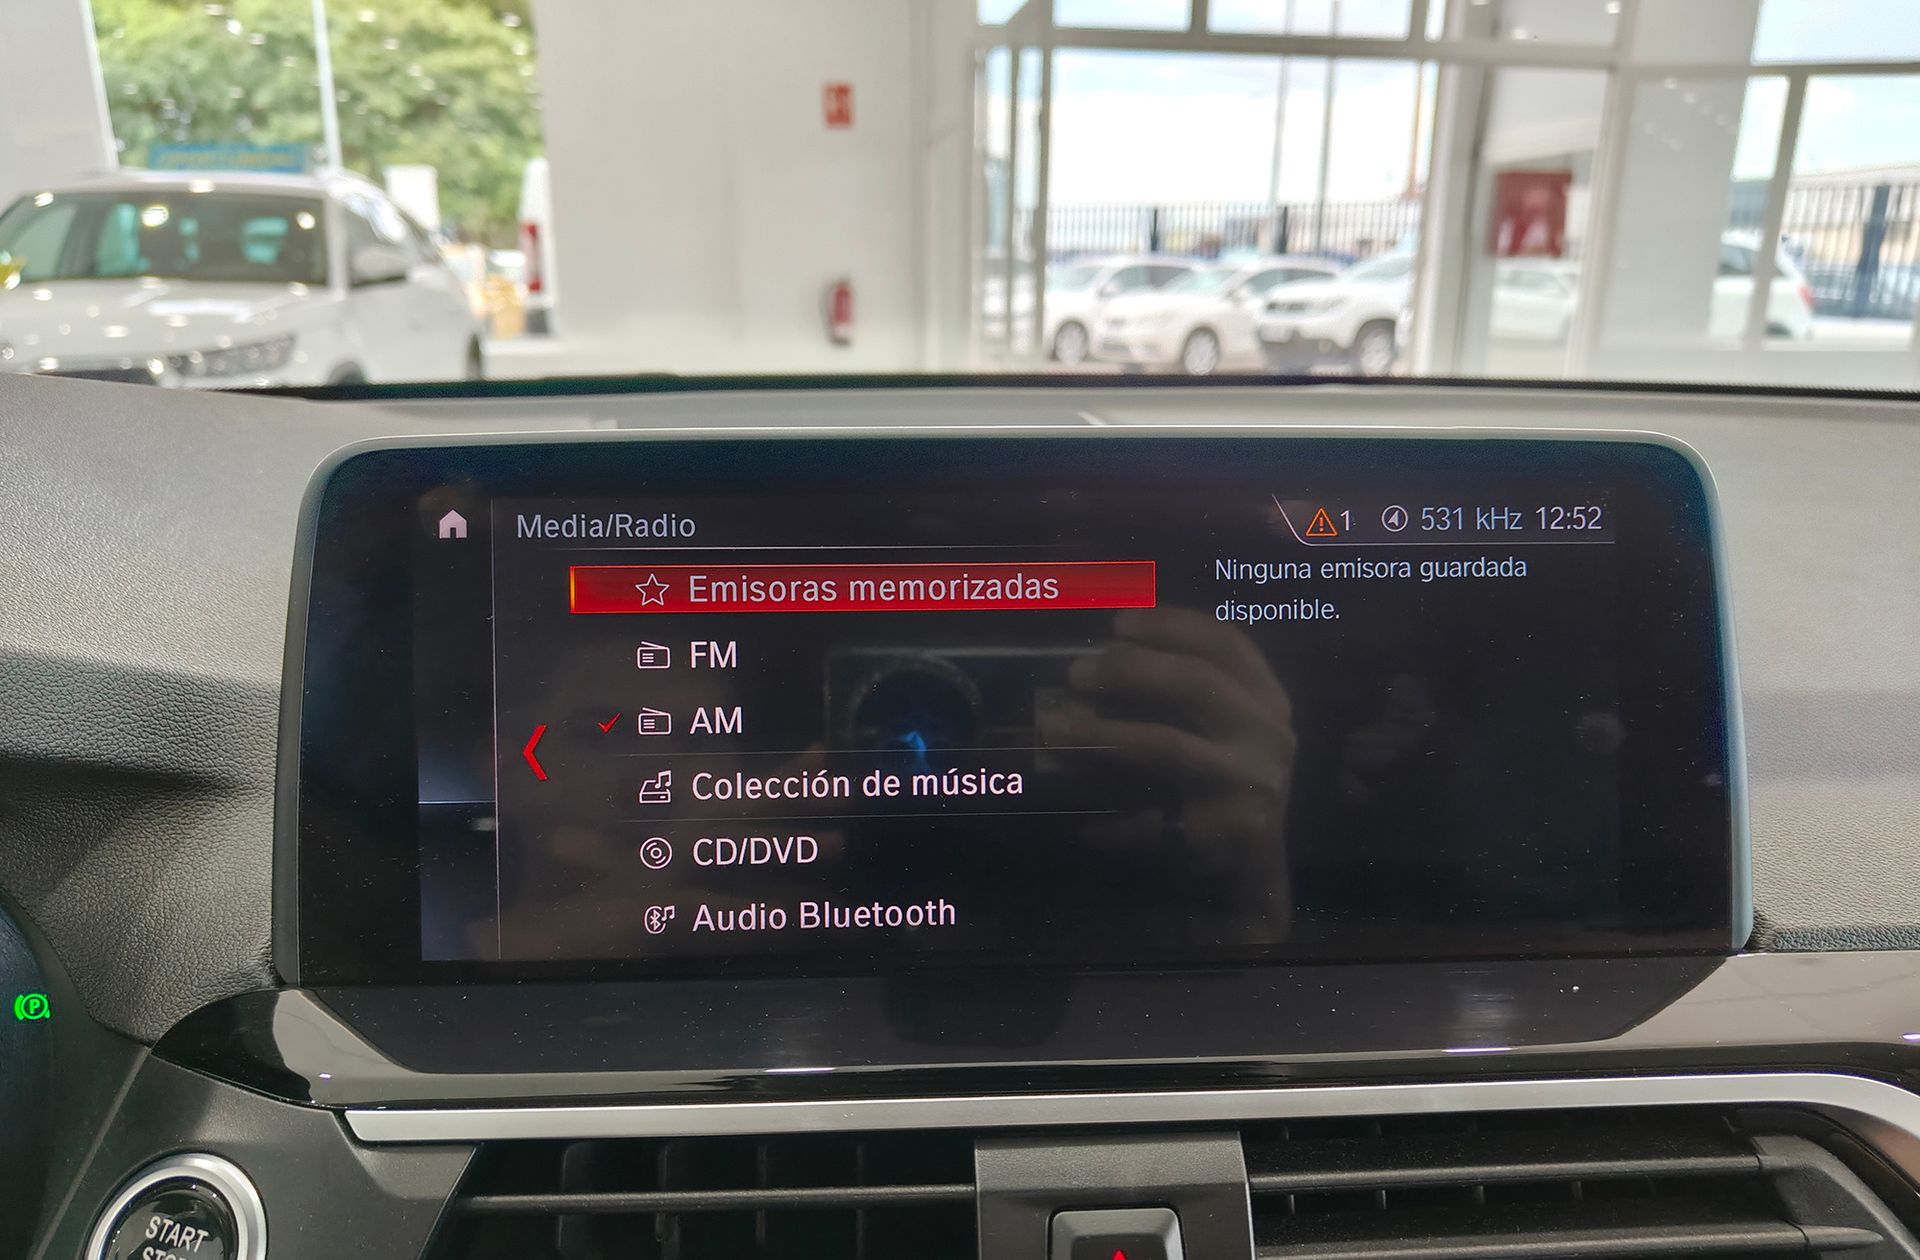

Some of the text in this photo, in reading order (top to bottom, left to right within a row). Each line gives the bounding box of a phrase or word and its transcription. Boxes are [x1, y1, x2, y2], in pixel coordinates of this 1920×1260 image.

[516, 512, 696, 540] Media/Radio
[1339, 510, 1353, 531] 1
[1420, 506, 1523, 531] 531 kHz
[1535, 506, 1603, 531] 12:52
[1214, 555, 1527, 584] Ninguna emisora guardada
[689, 572, 1059, 603] Emisoras memorizadas
[1215, 598, 1341, 625] disponible.
[690, 641, 738, 669] FM
[689, 707, 743, 735] AM
[691, 767, 1024, 801] Colección de música
[692, 836, 818, 867] CD/DVD
[692, 899, 957, 933] Audio Bluetooth
[145, 1215, 209, 1254] START
[142, 1246, 188, 1260] ST
